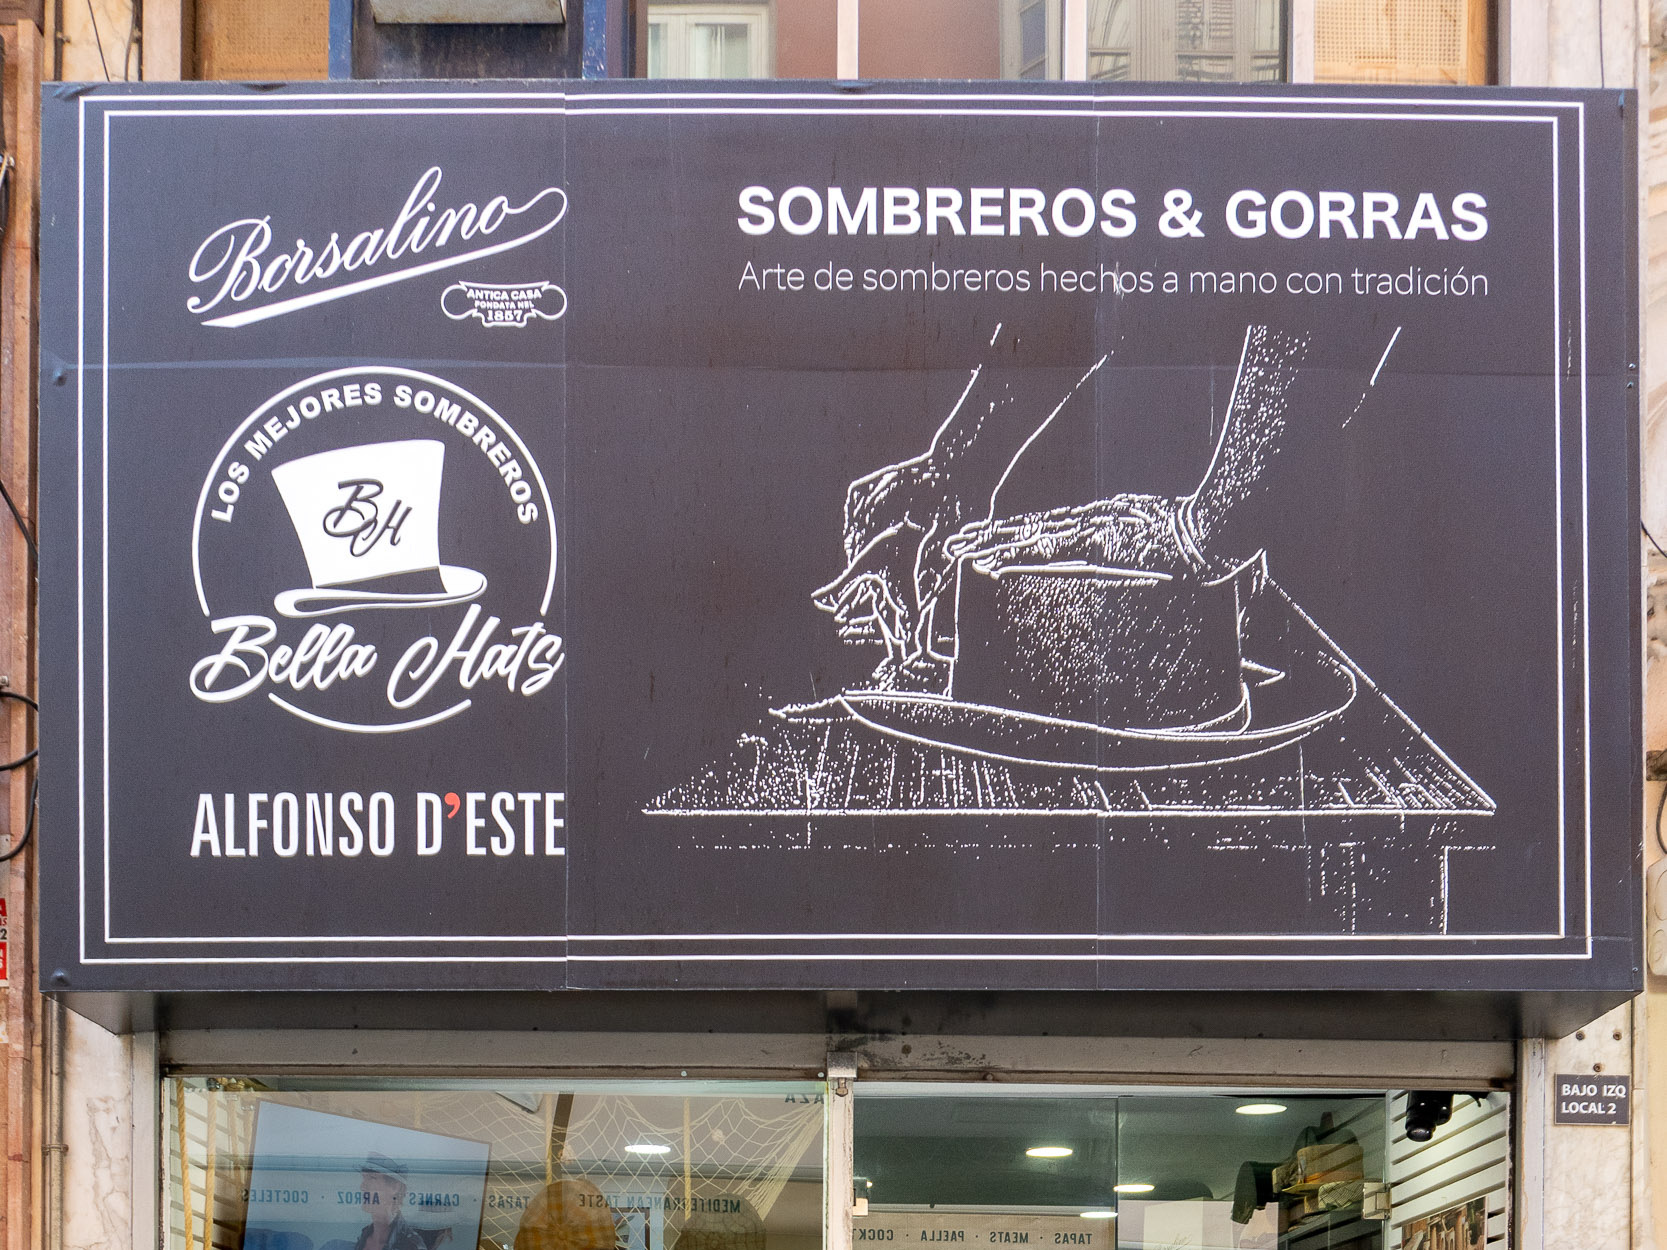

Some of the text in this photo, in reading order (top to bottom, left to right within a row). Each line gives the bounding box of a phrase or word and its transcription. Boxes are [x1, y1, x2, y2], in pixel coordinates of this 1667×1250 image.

[737, 186, 1489, 241] SOMBREROS & GORRAS
[187, 166, 568, 328] Borsalino
[467, 288, 542, 300] ANTICA CASA
[738, 261, 1488, 296] Arte de sombreros hechos a mano con tradición
[474, 300, 516, 310] FONDATA
[487, 310, 523, 321] 1857
[211, 382, 539, 525] LOS MEJORES SOMBREROS
[190, 604, 565, 708] Bella Hats
[190, 791, 566, 857] ALFONSO D'ESTE
[1561, 1084, 1626, 1098] BAJO IZQ
[1561, 1102, 1617, 1114] LOCAL 2
